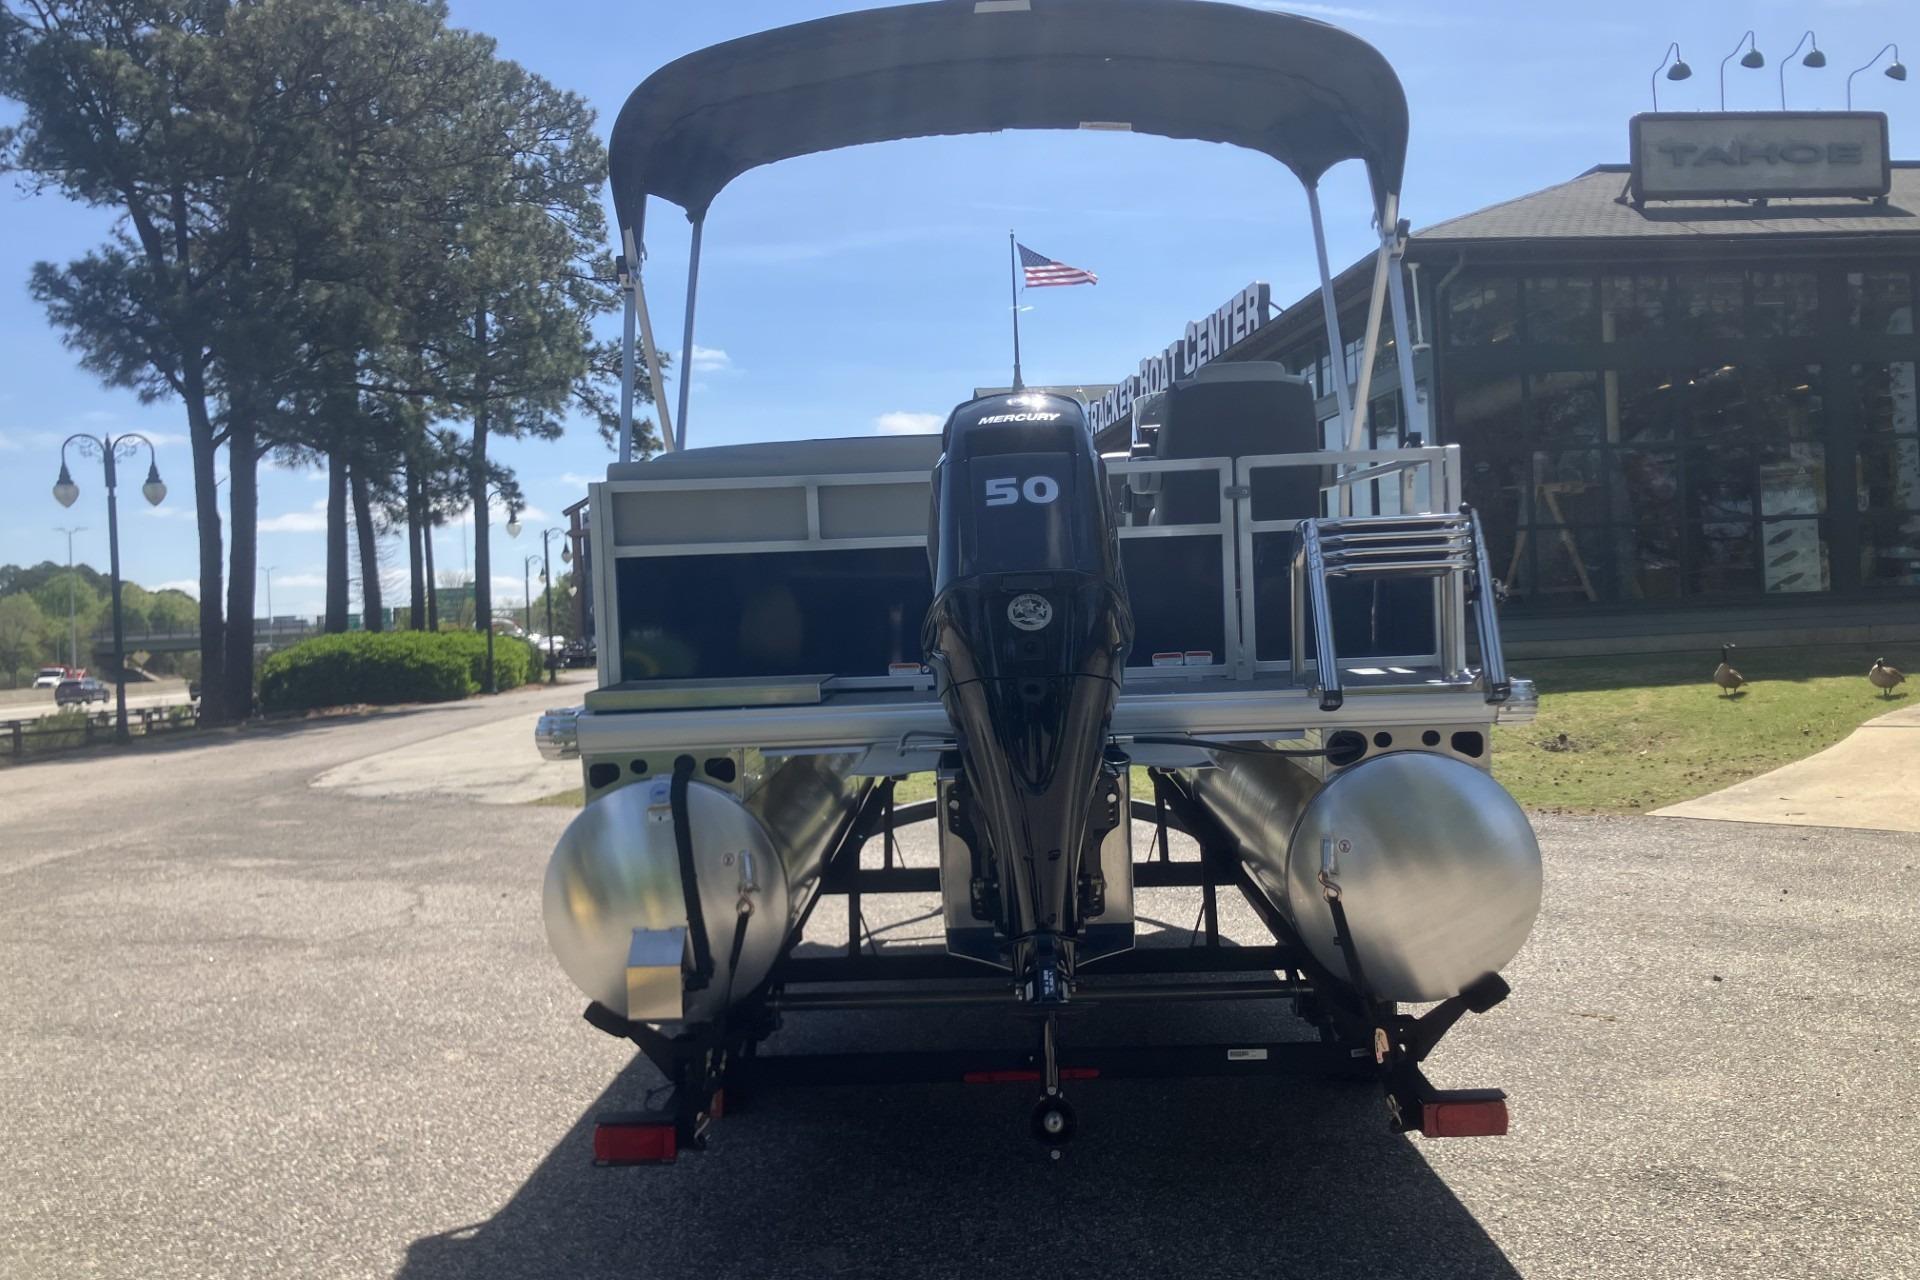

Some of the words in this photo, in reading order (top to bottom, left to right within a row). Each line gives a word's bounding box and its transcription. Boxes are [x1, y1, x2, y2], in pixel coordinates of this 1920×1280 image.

[1656, 141, 1863, 168] TAHOE
[1139, 343, 1181, 397] BOAT
[1183, 281, 1264, 375] CENTER
[978, 413, 1060, 425] MERCURY
[985, 476, 1058, 506] 50
